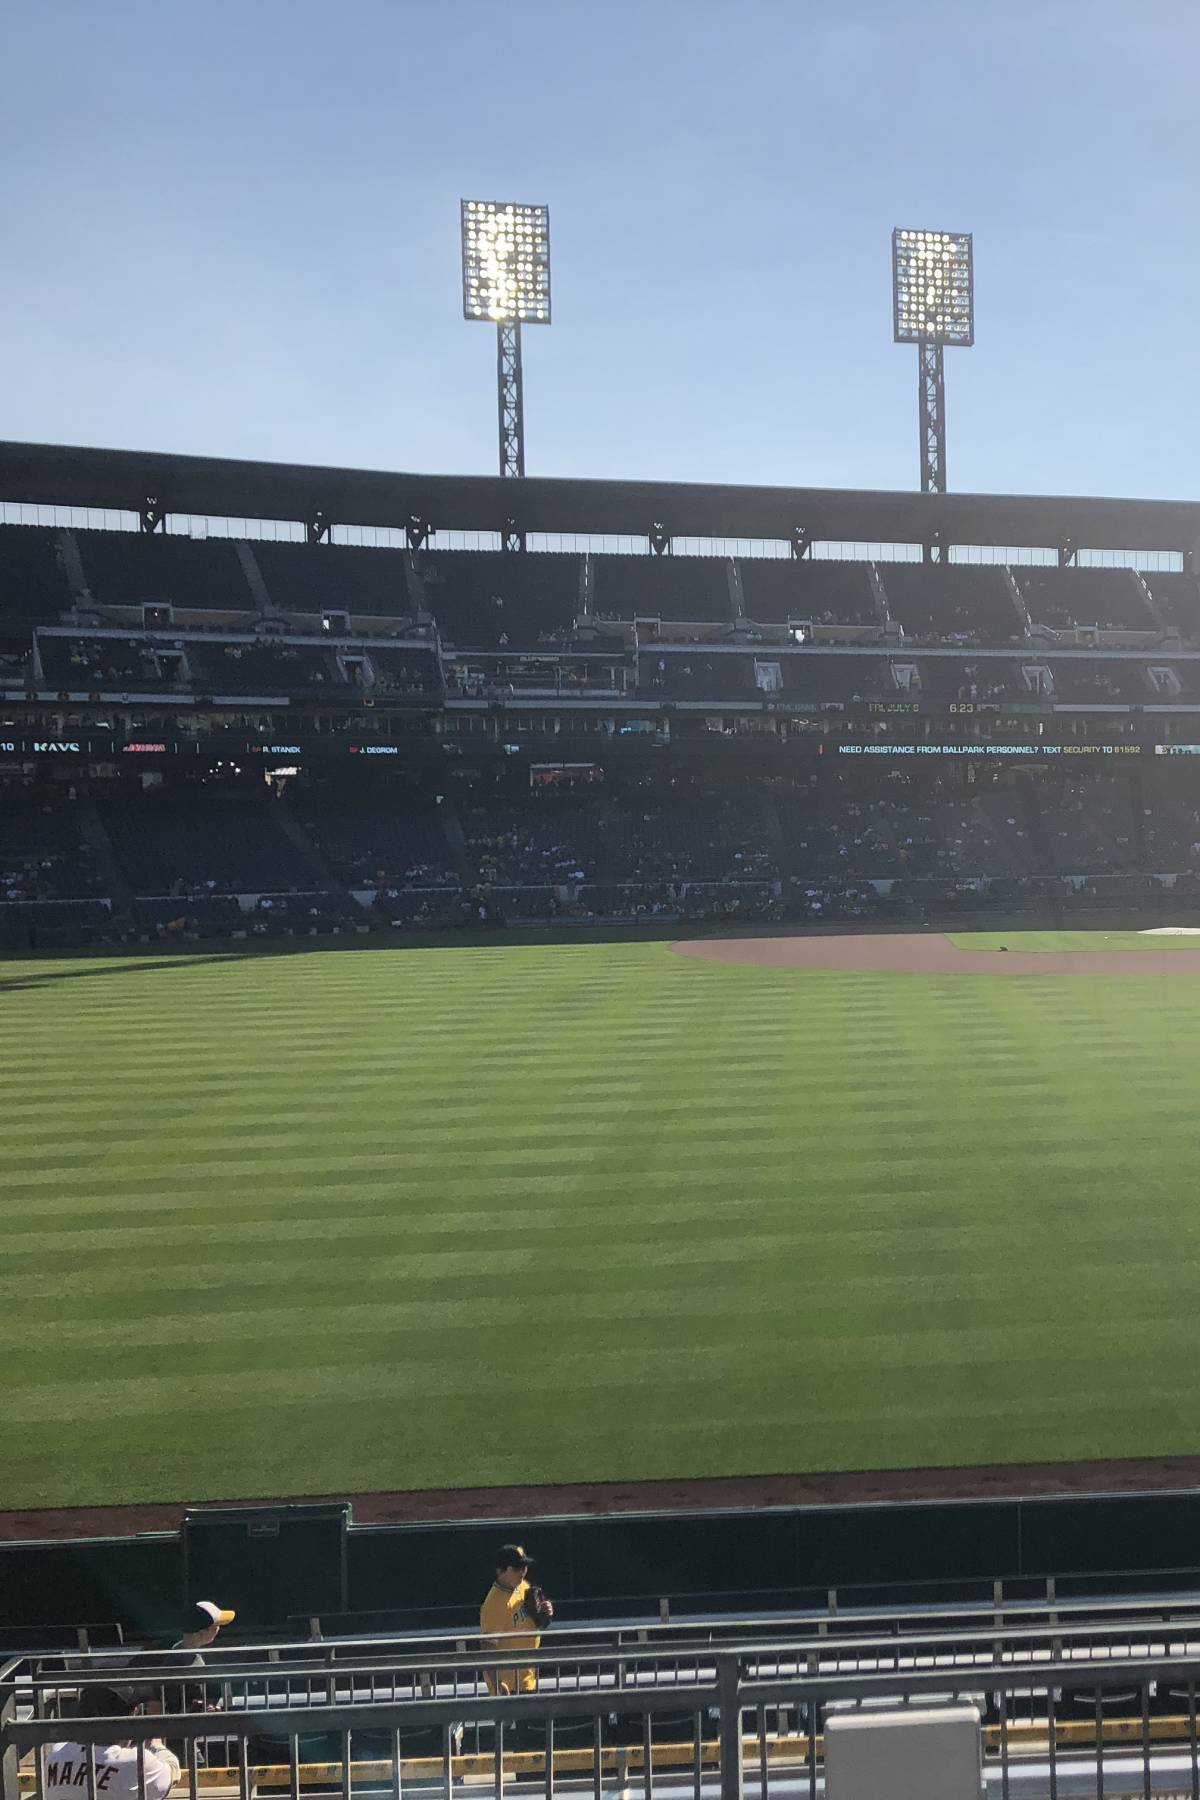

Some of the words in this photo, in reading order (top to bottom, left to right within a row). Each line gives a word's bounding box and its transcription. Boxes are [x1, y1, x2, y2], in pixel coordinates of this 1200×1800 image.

[839, 745, 862, 754] NEED
[863, 745, 915, 754] ASSISTANCE
[916, 745, 941, 754] FROM
[942, 745, 985, 754] BALLPARK
[986, 745, 1039, 754] PERSONNEL?
[1042, 746, 1061, 754] TEXT
[1063, 746, 1101, 754] SECURITY
[1102, 746, 1113, 754] TO
